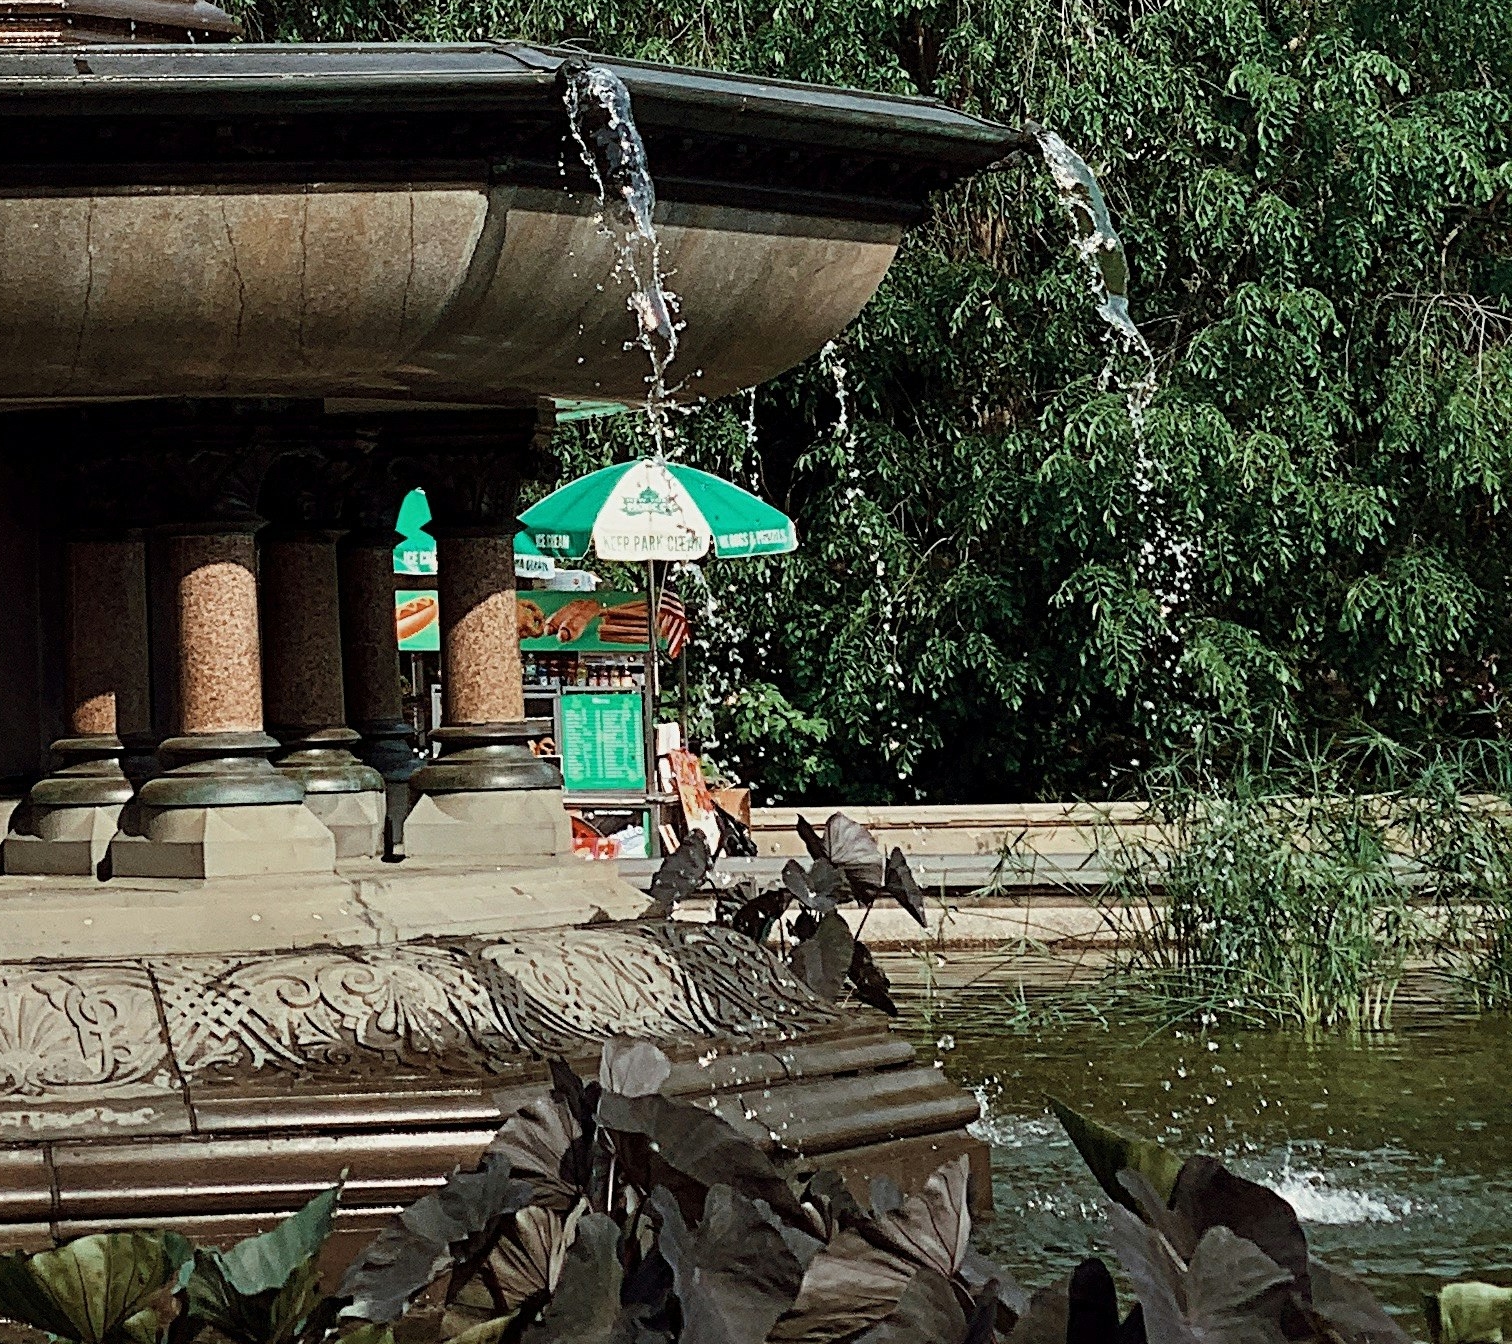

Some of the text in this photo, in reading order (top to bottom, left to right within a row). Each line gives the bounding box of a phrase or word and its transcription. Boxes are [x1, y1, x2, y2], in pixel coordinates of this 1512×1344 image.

[603, 535, 630, 552] KEEP
[633, 535, 663, 552] PARK
[667, 535, 703, 552] CLEAN
[403, 550, 418, 566] ICE
